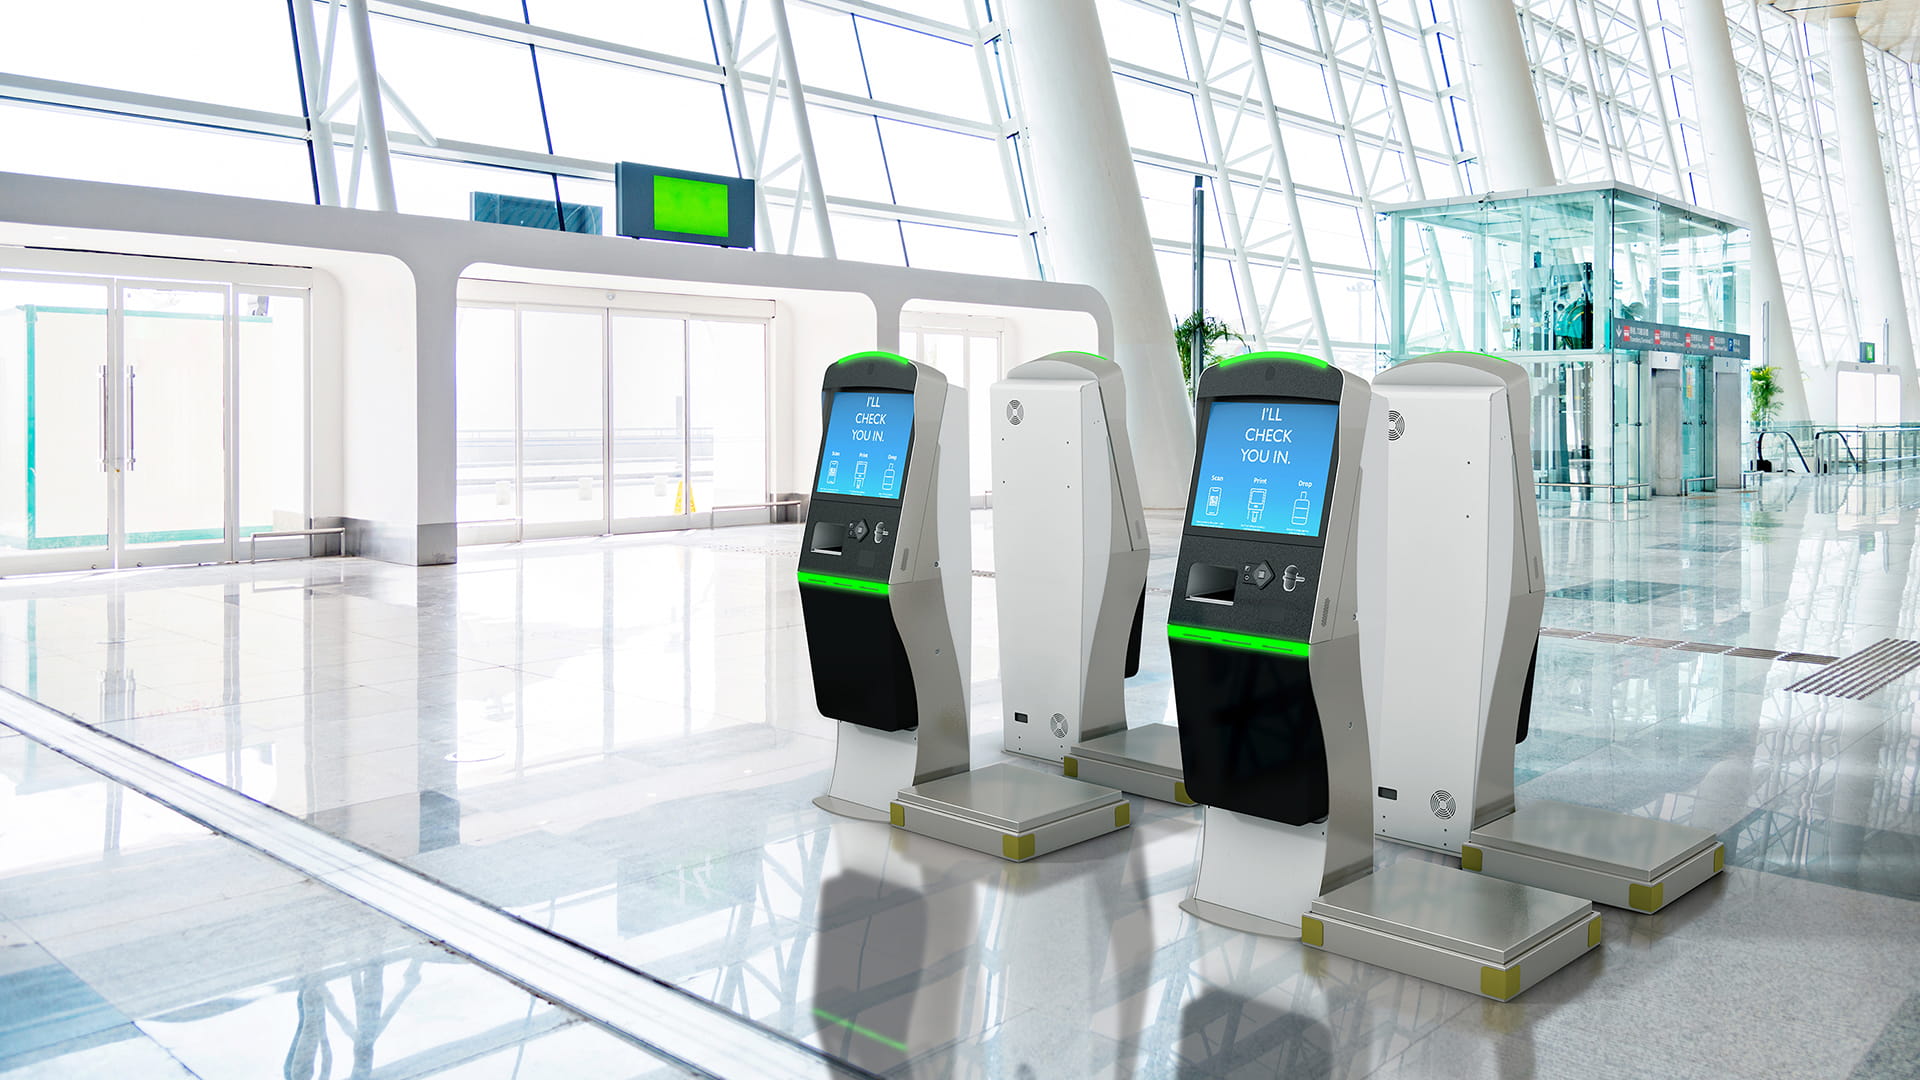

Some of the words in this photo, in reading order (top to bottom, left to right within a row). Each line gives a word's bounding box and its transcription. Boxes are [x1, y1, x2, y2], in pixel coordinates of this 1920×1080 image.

[866, 396, 880, 408] I'LL
[855, 413, 887, 425] CHECK
[1261, 407, 1282, 421] I'LL
[851, 429, 871, 441] YOU
[872, 430, 885, 442] IN.
[1245, 428, 1293, 443] CHECK
[1240, 448, 1270, 463] YOU
[1272, 450, 1291, 465] IN.
[1253, 477, 1268, 485] Print
[1298, 480, 1313, 489] Drop
